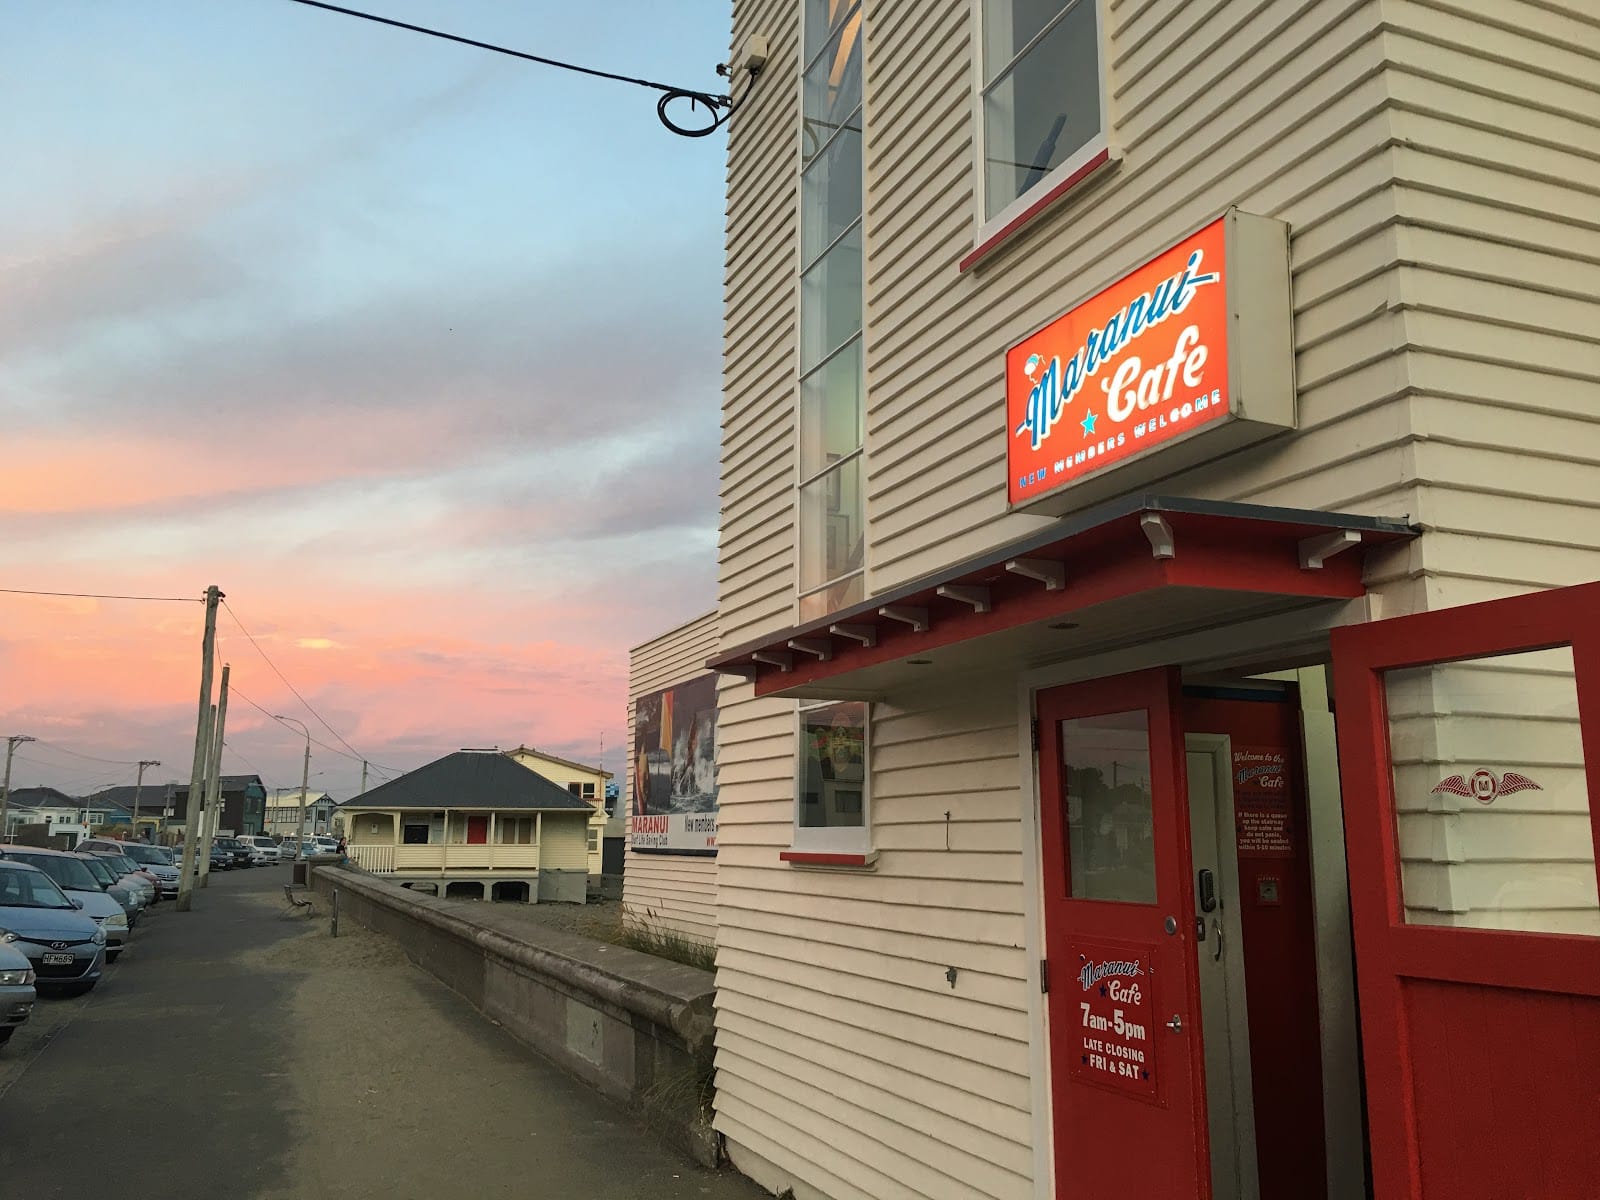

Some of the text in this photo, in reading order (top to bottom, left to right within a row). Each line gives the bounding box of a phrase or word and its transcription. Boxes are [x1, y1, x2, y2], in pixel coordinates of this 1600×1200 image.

[1016, 249, 1220, 450] Maranui
[1101, 325, 1208, 422] Cafe
[1019, 389, 1221, 488] NEW MEMBERS WELCOME
[1234, 751, 1264, 761] Welcome
[1265, 753, 1272, 761] to
[1259, 776, 1284, 787] Cafe
[632, 816, 668, 833] MARANUI
[684, 814, 694, 832] New
[695, 813, 715, 832] members
[659, 834, 668, 845] Club
[1077, 959, 1144, 991] Maranui
[1108, 980, 1142, 1005] Cafe
[1080, 1002, 1146, 1040] 7am-5pm
[1083, 1037, 1145, 1063] LATE CLOSING
[1089, 1054, 1139, 1080] FRI & SAT
